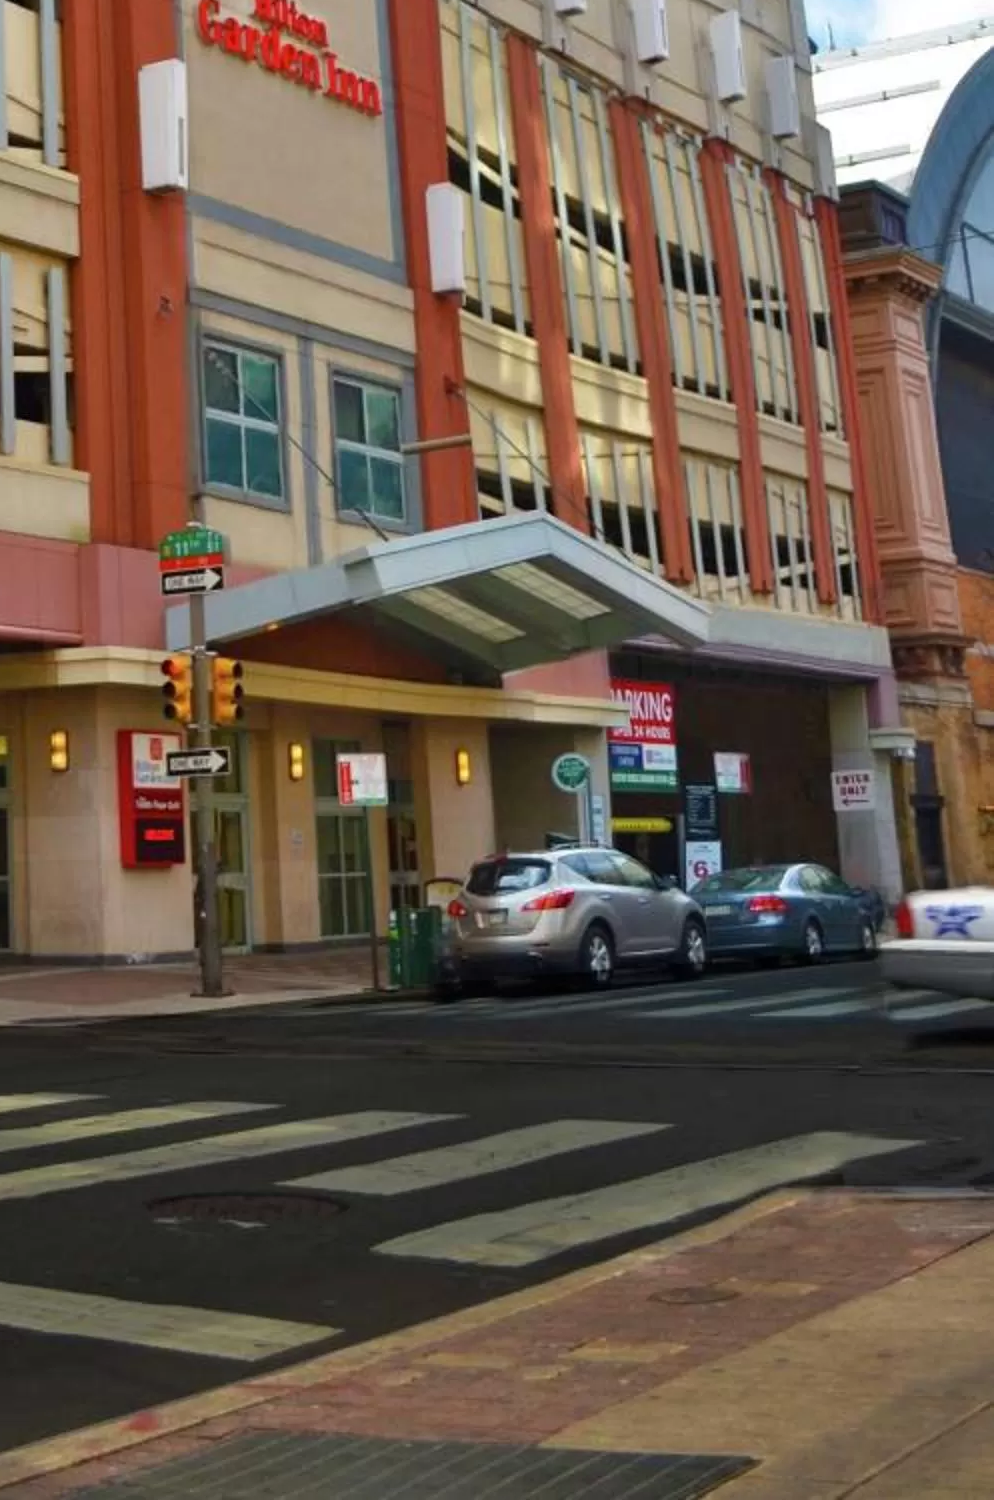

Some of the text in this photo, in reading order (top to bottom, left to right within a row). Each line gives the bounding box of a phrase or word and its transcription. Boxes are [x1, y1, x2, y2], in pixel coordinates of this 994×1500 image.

[323, 52, 381, 117] Inn
[166, 574, 204, 591] ONE WAY
[170, 758, 188, 770] ONE
[192, 756, 209, 768] WAY
[835, 773, 870, 785] ENTER
[840, 785, 867, 797] ONLY
